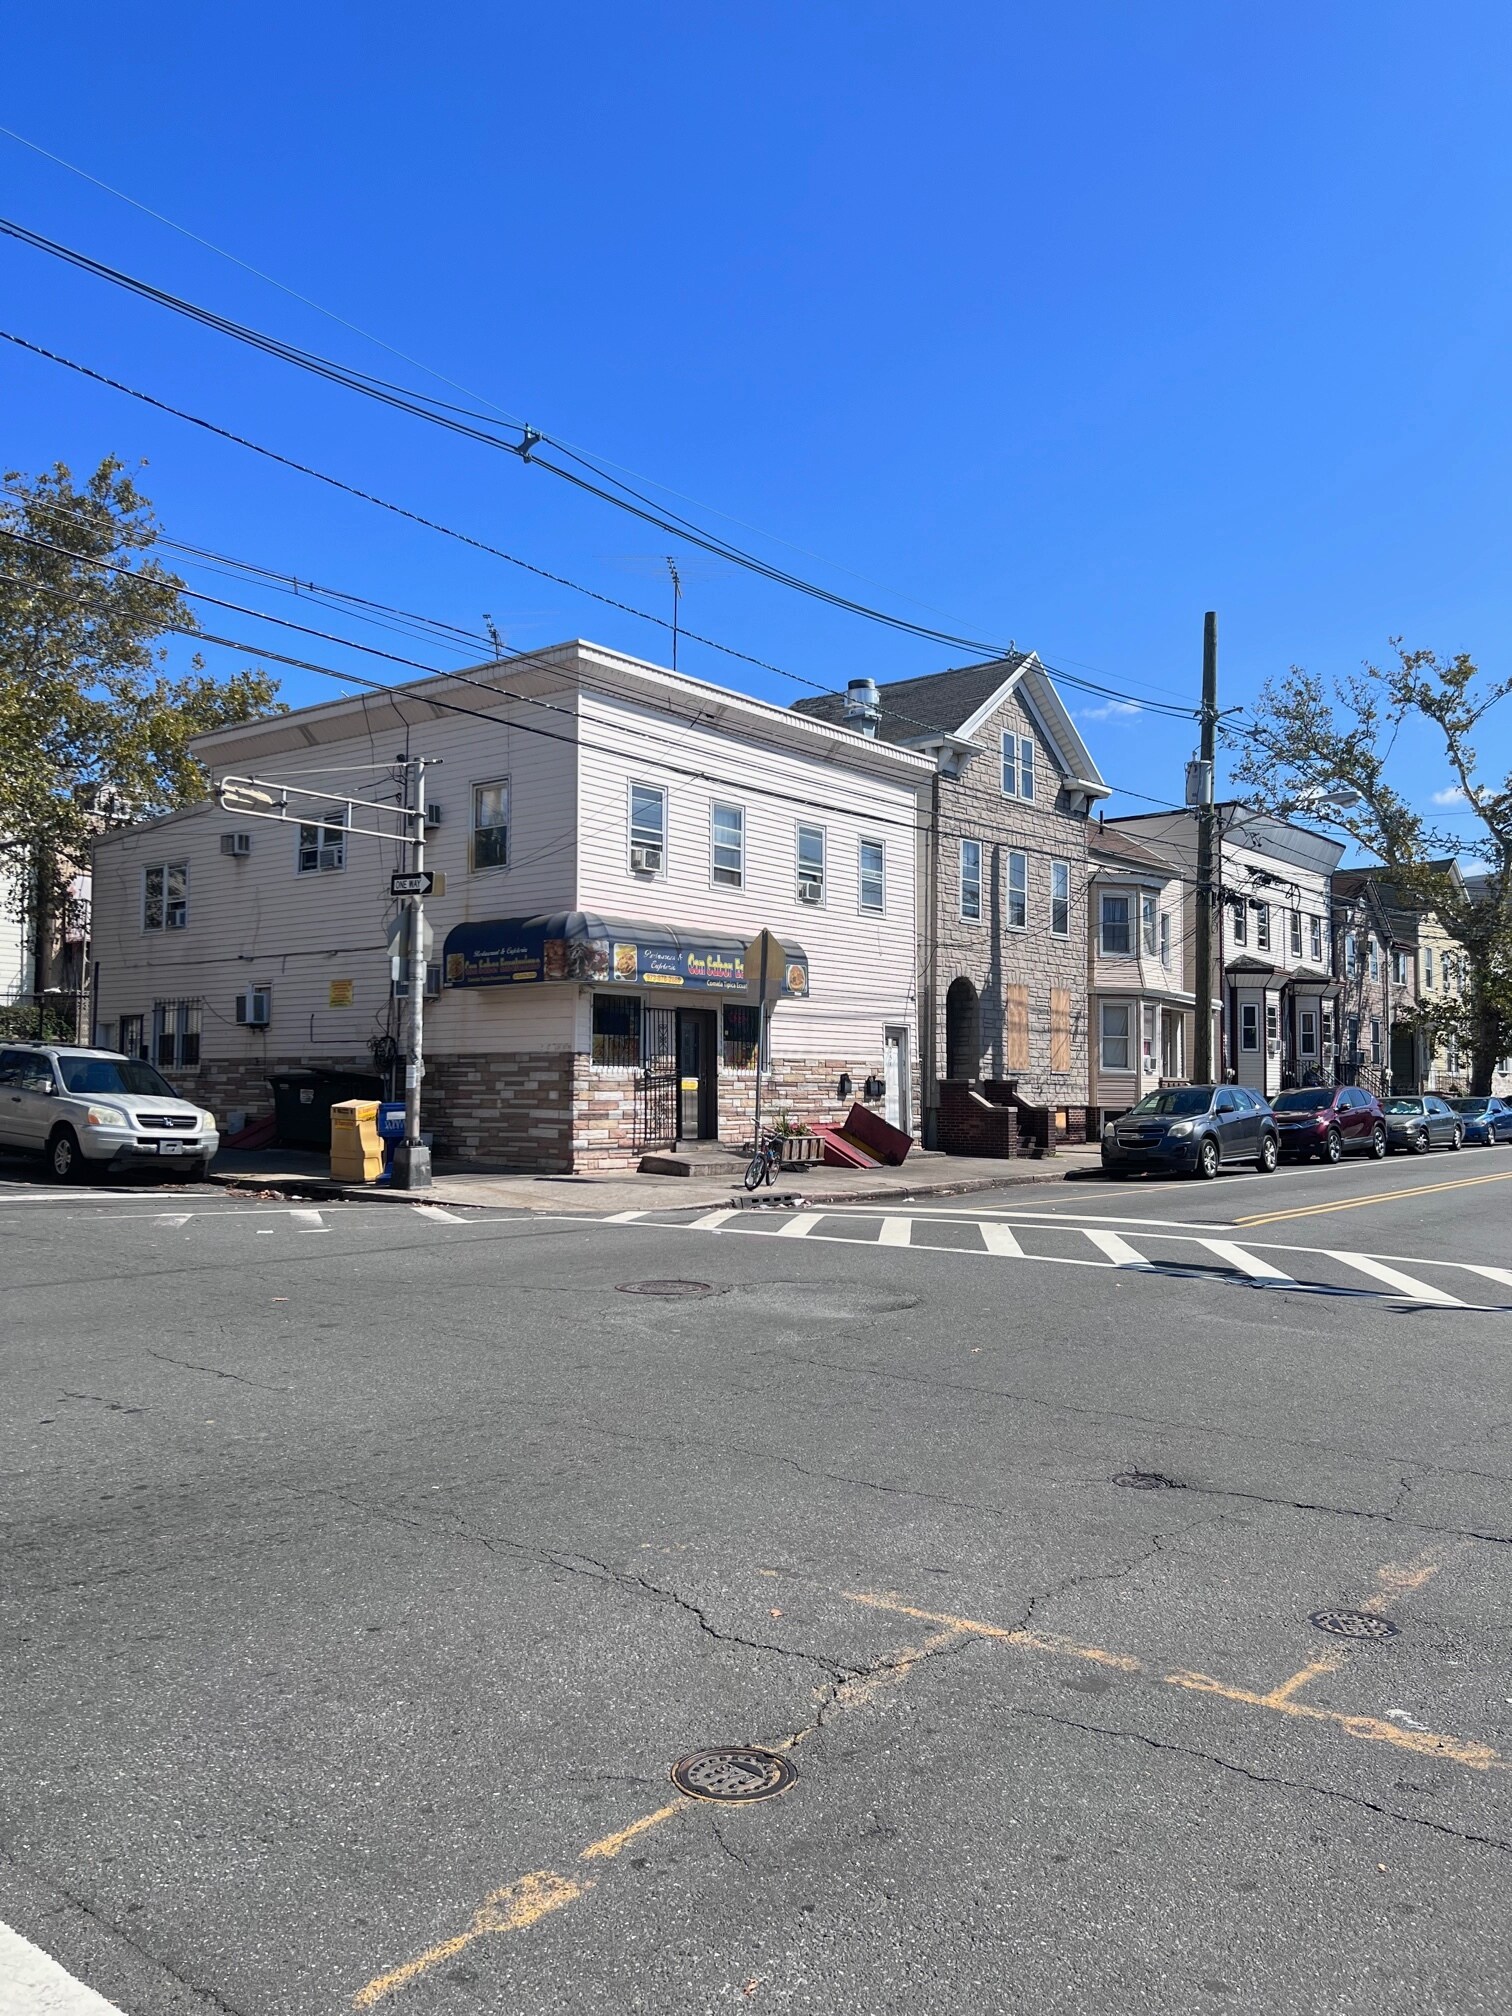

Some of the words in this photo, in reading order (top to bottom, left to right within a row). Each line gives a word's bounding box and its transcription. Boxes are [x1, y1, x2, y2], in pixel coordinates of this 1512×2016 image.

[395, 880, 407, 889] ONE
[408, 880, 421, 888] WAY
[687, 952, 706, 976] Con
[706, 954, 734, 978] Sabor
